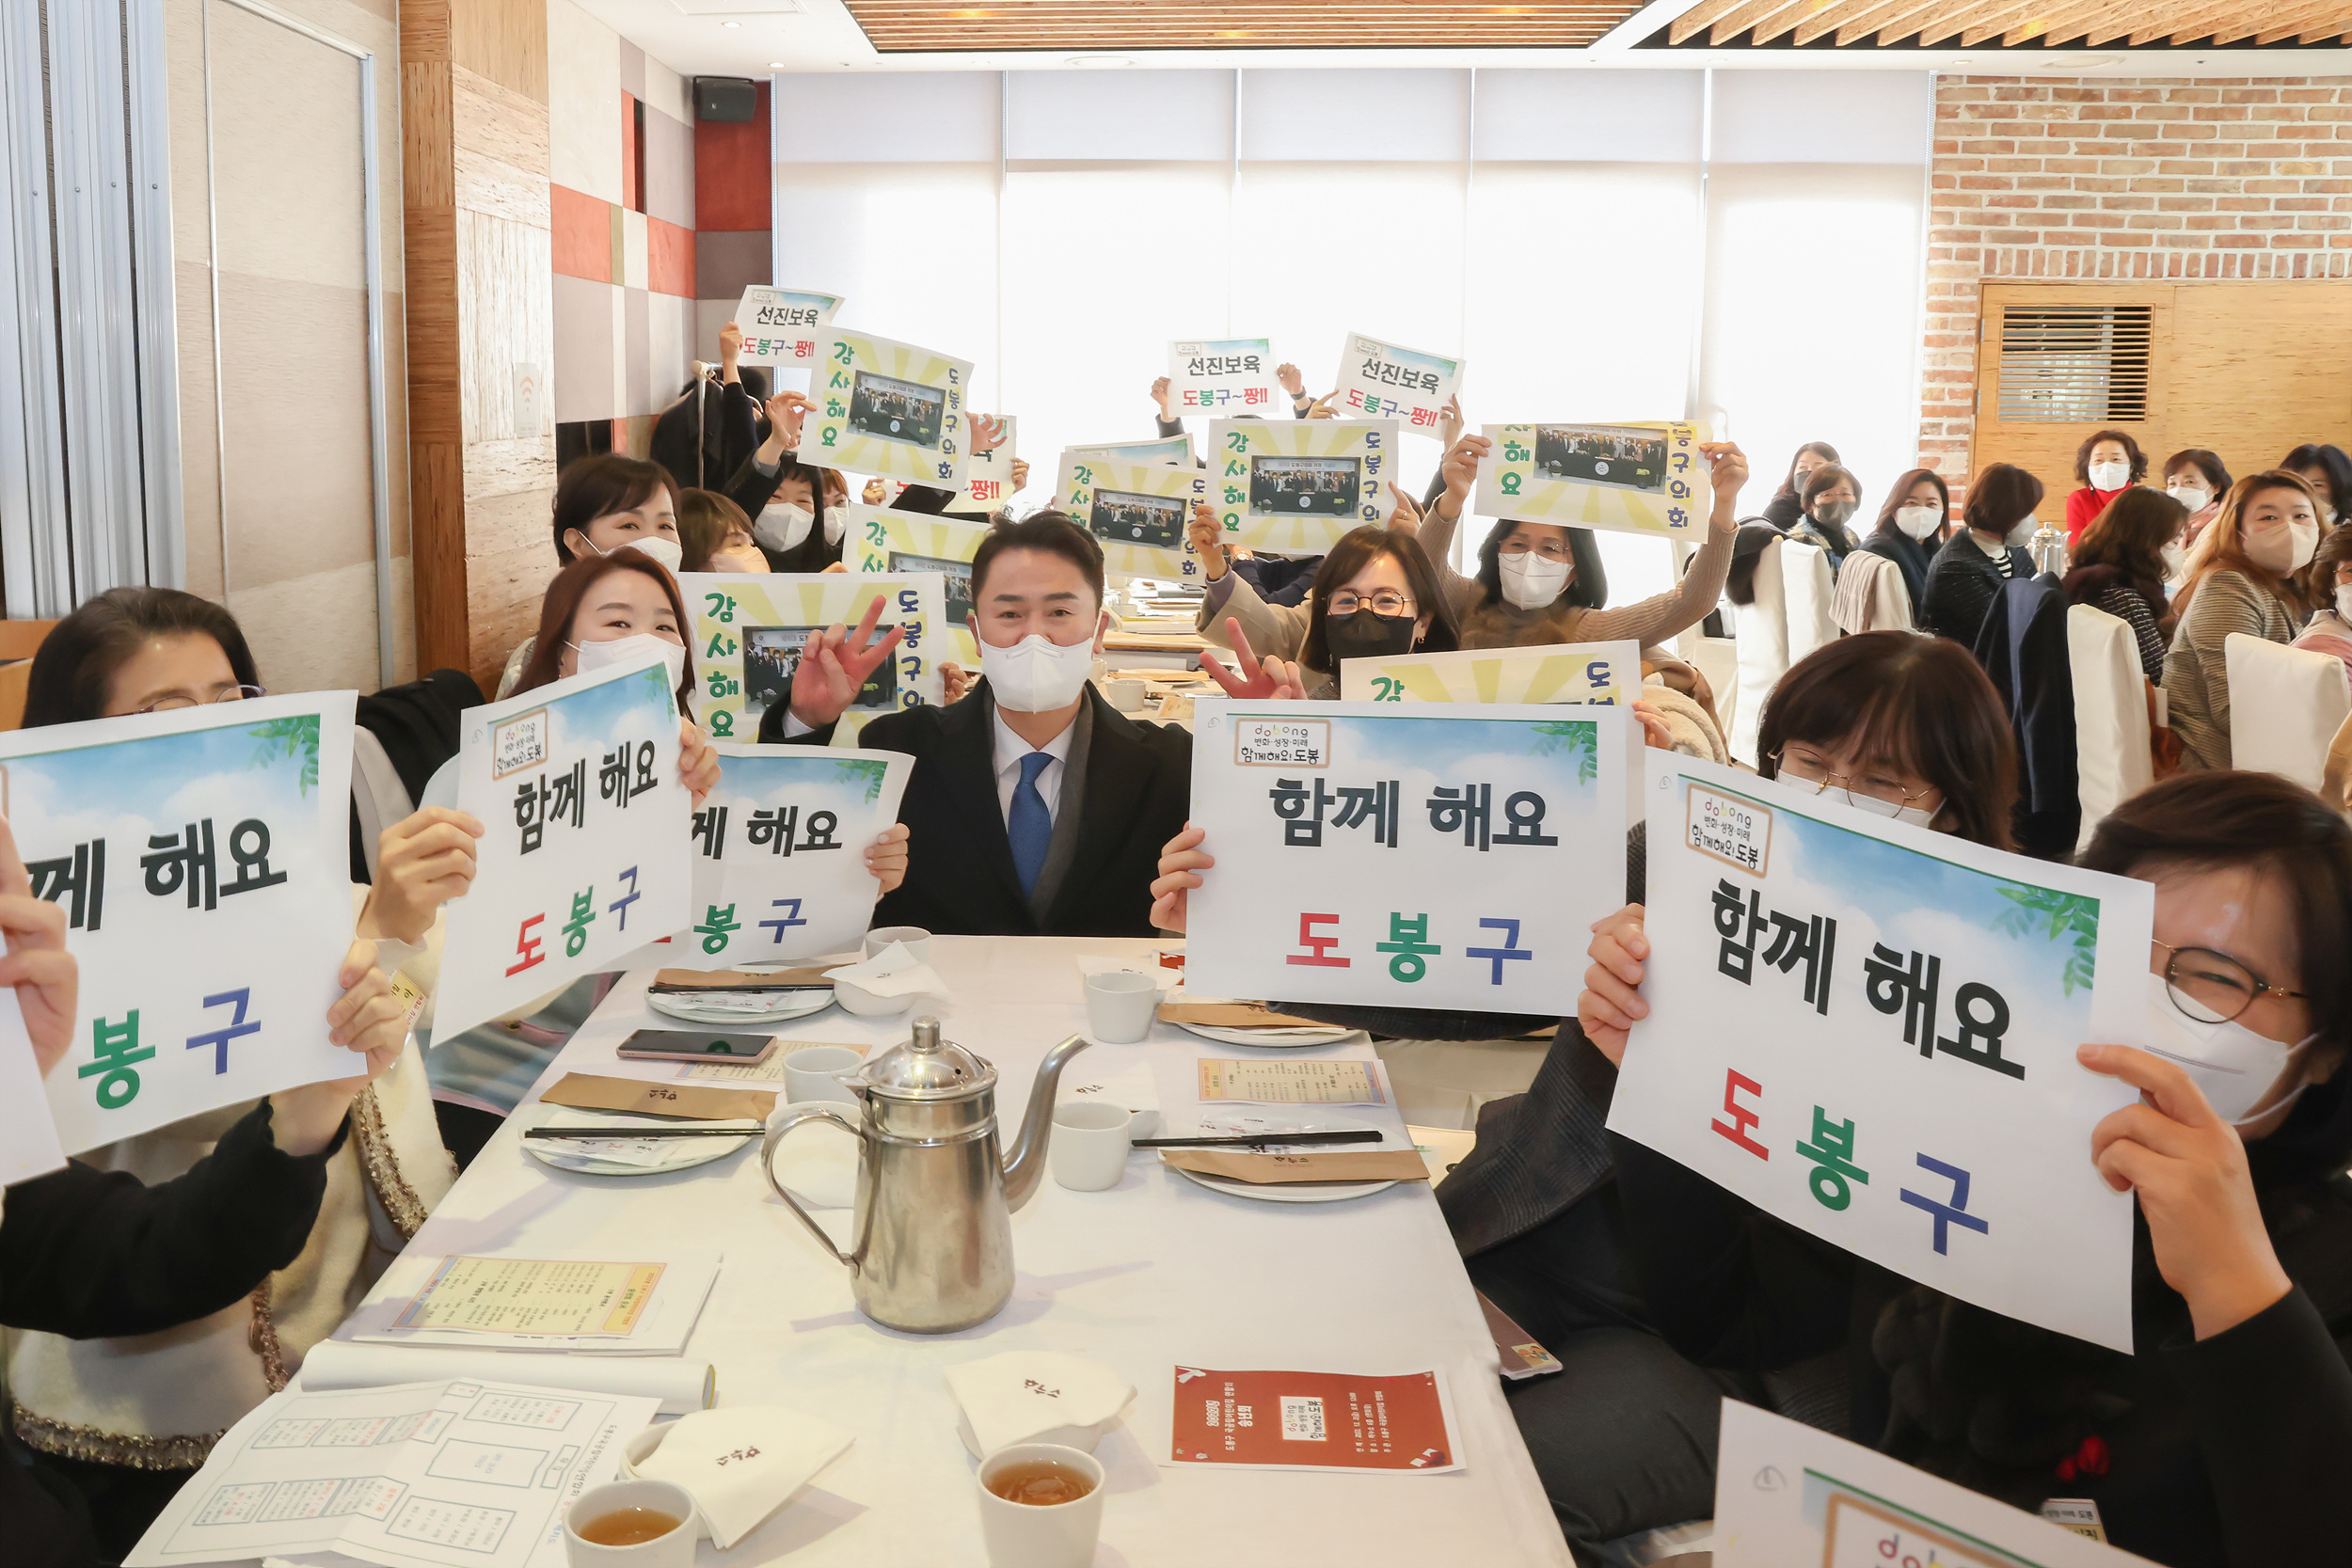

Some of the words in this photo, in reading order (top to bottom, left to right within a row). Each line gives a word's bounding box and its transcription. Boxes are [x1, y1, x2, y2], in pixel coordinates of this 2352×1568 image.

[756, 306, 818, 327] 선진보육
[821, 341, 854, 447] 감사해요
[1183, 388, 1268, 406] 도봉구~짱!!
[1187, 355, 1260, 376] 선진보육
[1361, 357, 1439, 394] 선진보육
[938, 367, 961, 480] 도봉구의회
[1346, 388, 1438, 427] 도봉구~짱!!
[1070, 466, 1093, 528] 감사해
[1223, 432, 1249, 532] 감사해요
[1362, 432, 1382, 521] 도봉구의
[705, 593, 739, 737] 감사해요
[898, 590, 925, 707] 도봉구의
[1254, 724, 1309, 738] dobong
[513, 757, 585, 855] 함께
[598, 739, 658, 808] 해요
[747, 806, 843, 857] 해요
[1269, 778, 1400, 848] 함께
[1426, 784, 1558, 852] 해요
[1705, 797, 1752, 829] dobong
[25, 837, 105, 932] 께
[139, 816, 288, 911] 해요
[693, 898, 807, 955] 봉구
[1711, 879, 1836, 1016] 함께
[1864, 942, 2025, 1081] 해요
[78, 986, 262, 1110] 봉구
